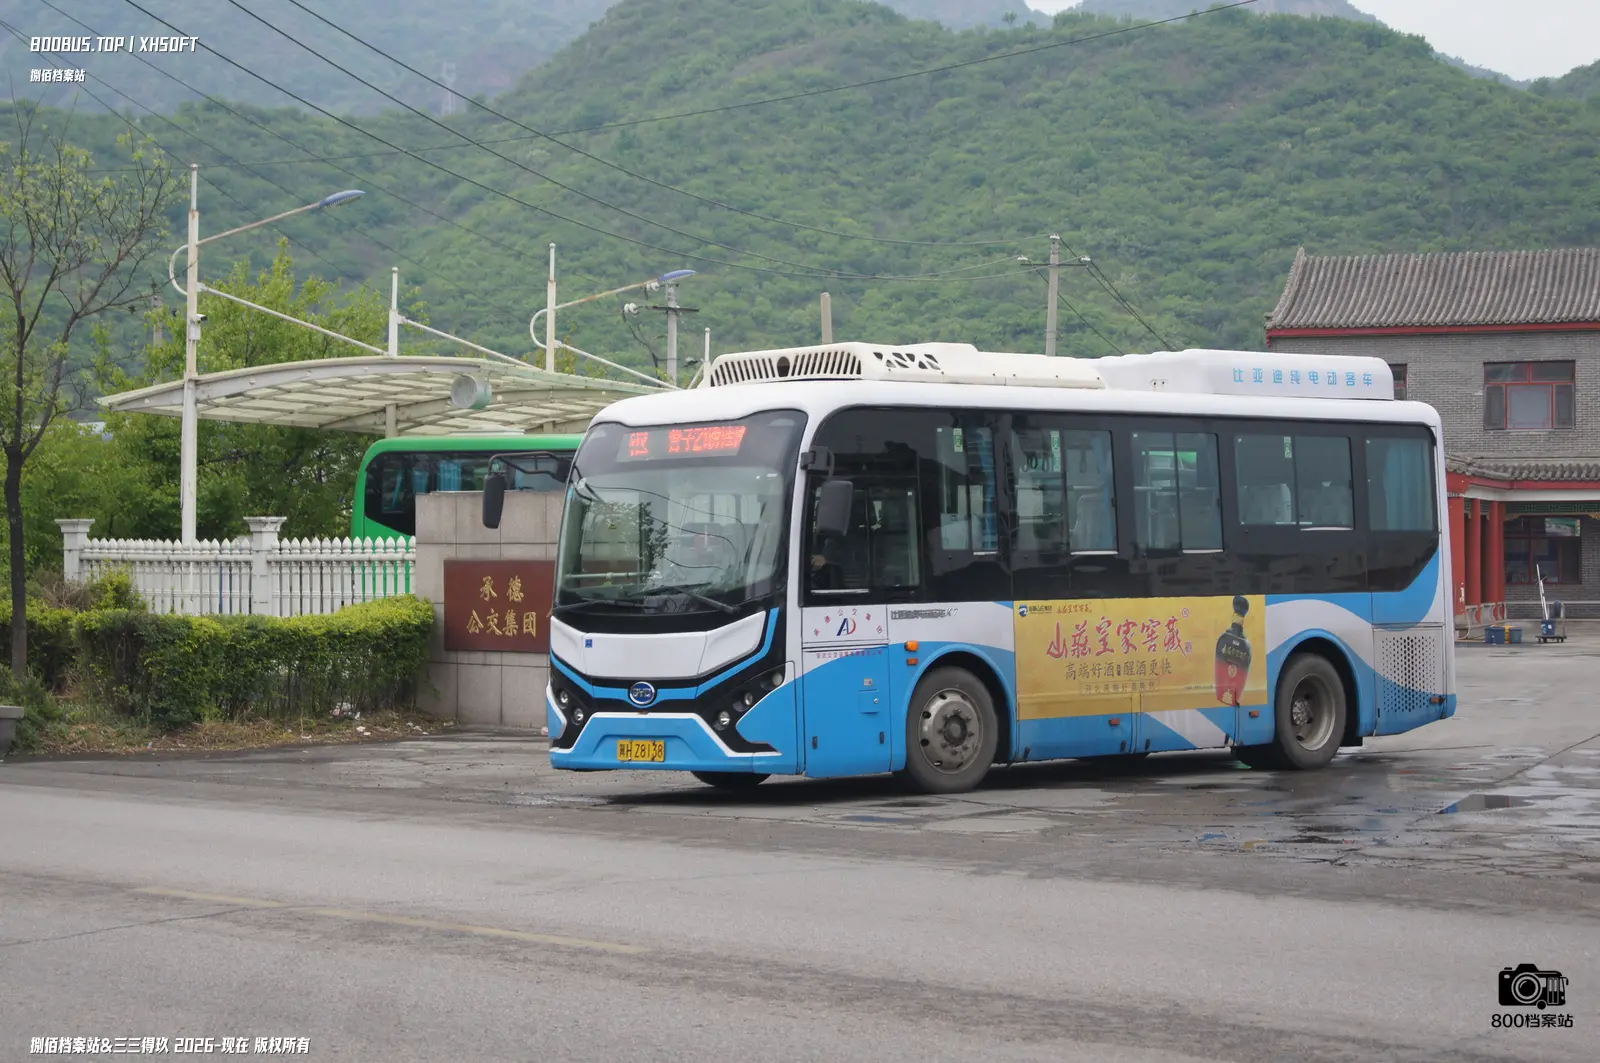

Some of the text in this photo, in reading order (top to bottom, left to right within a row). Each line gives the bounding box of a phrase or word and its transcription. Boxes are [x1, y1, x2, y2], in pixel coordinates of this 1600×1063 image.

[1232, 367, 1373, 387] 比亚迪纯电动客车
[479, 575, 525, 602] 承德
[466, 607, 537, 638] 公交集团
[1065, 661, 1115, 681] 高端好酒
[1123, 658, 1173, 677] 醒酒更快
